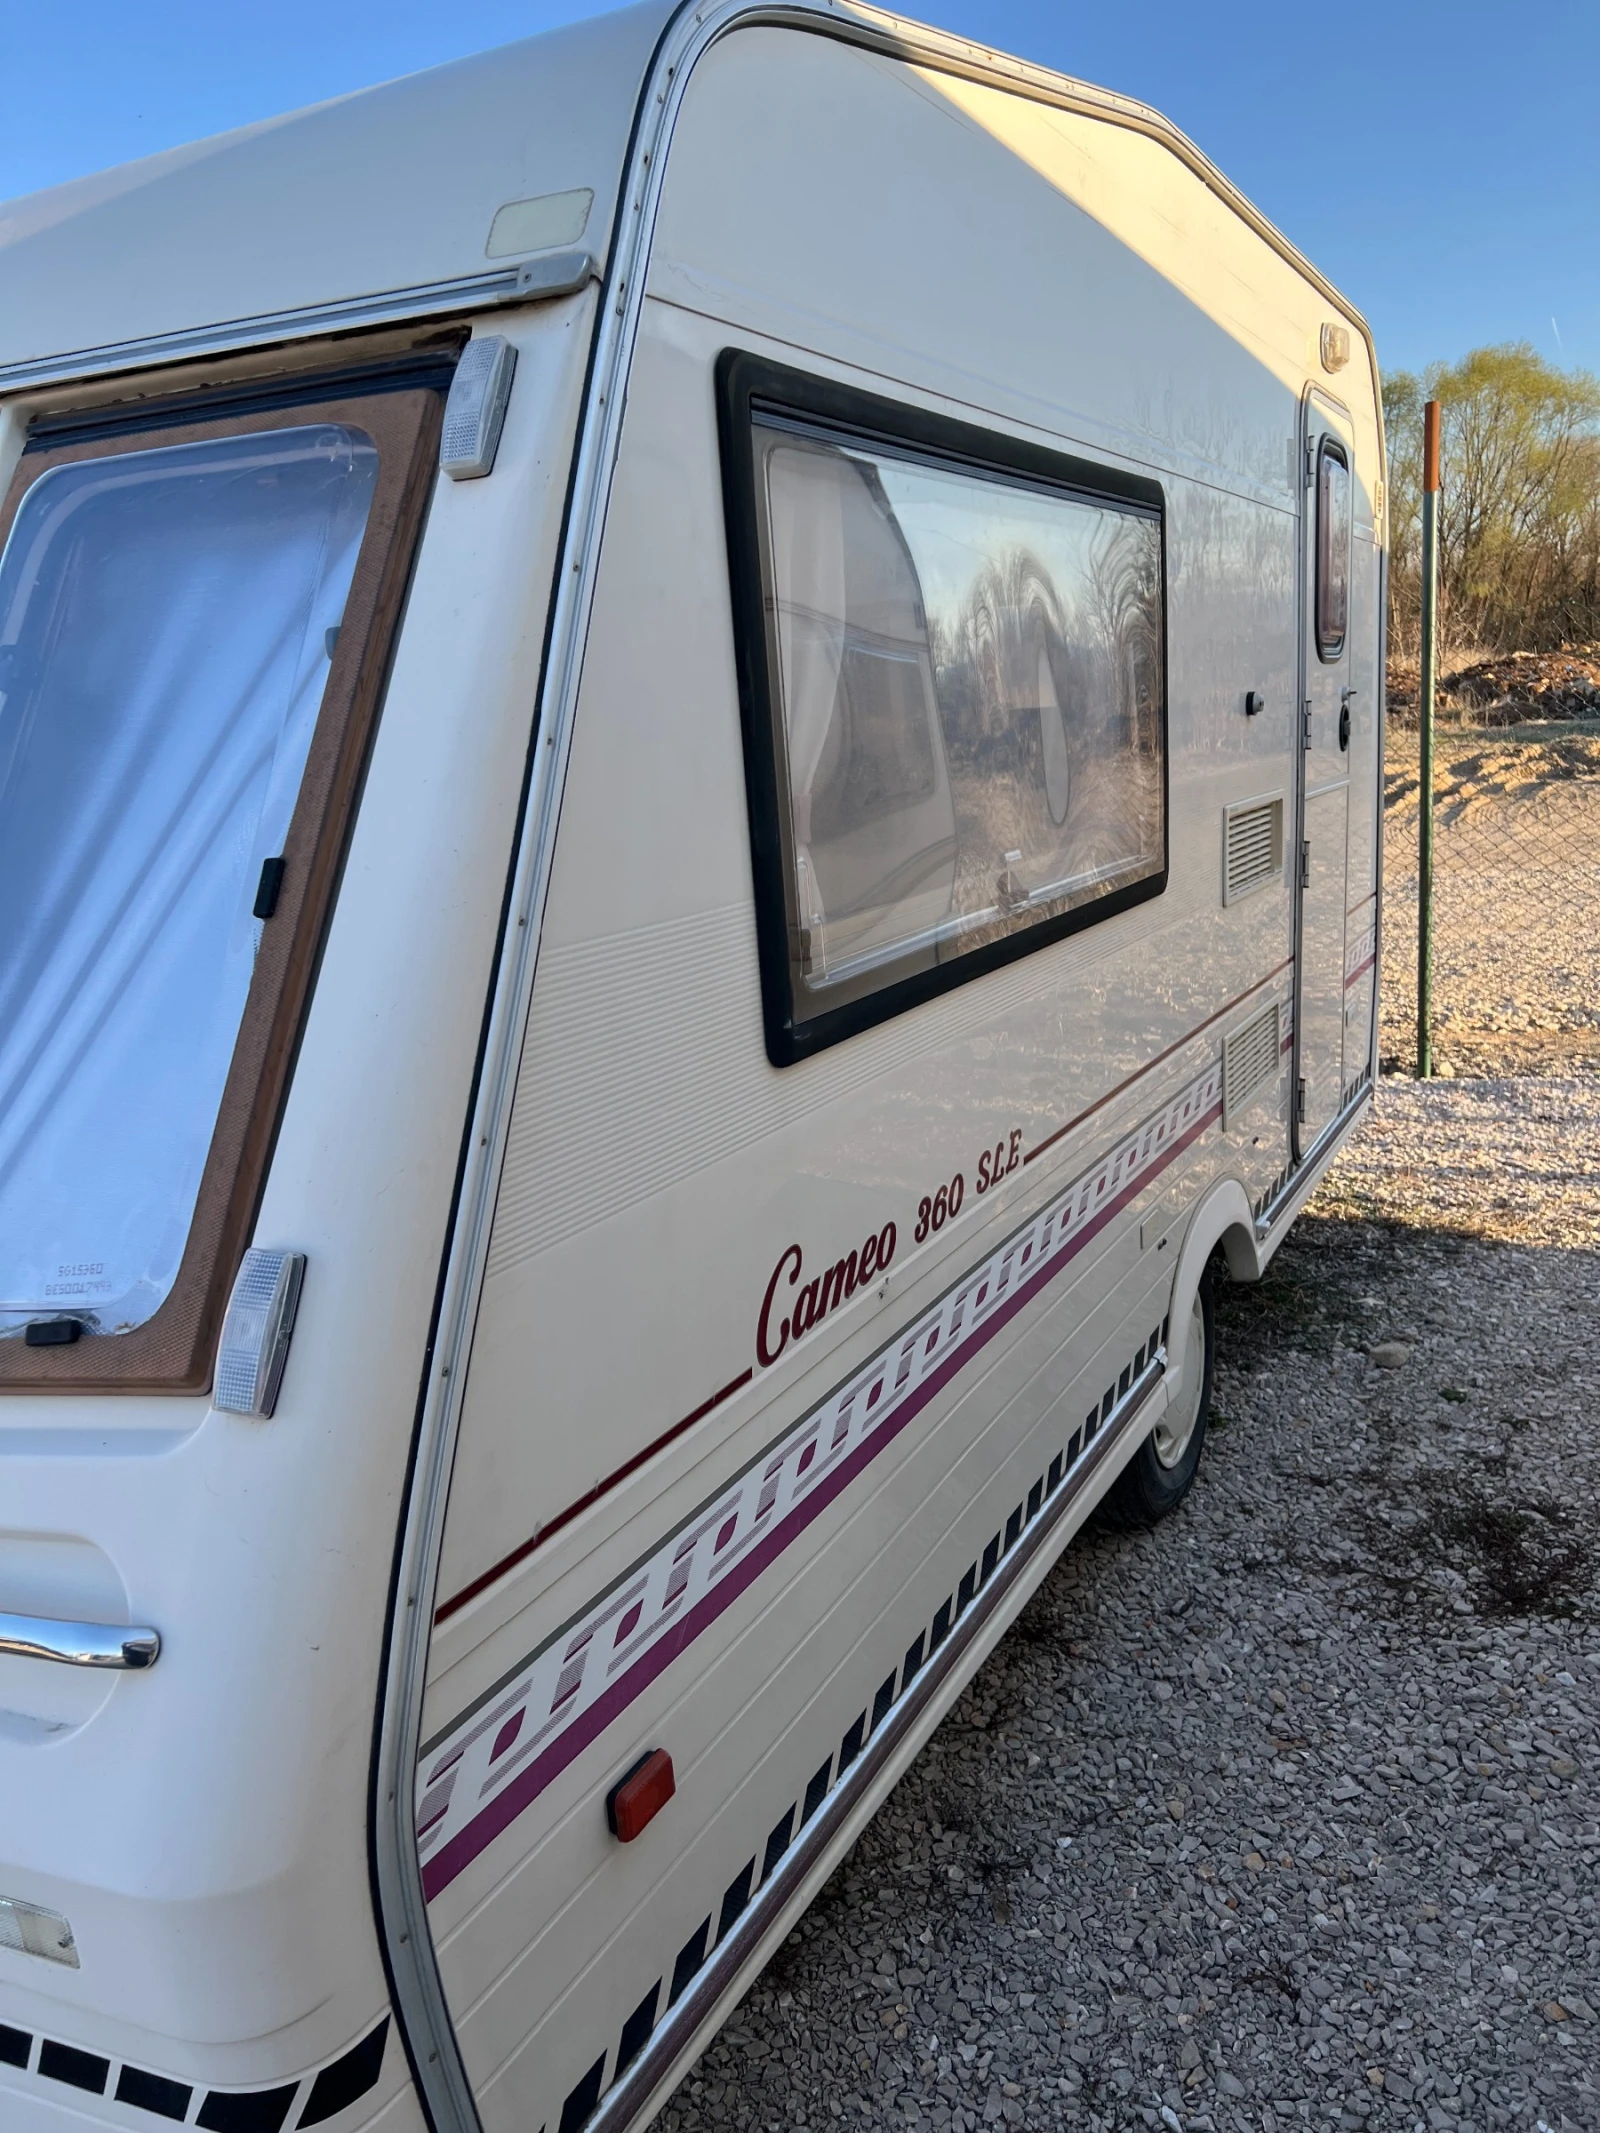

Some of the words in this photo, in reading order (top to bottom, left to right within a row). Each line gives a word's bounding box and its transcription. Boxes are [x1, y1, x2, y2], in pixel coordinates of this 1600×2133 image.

[756, 1220, 896, 1367] Cameo
[914, 1173, 964, 1244] 360
[976, 1128, 1022, 1194] SLE
